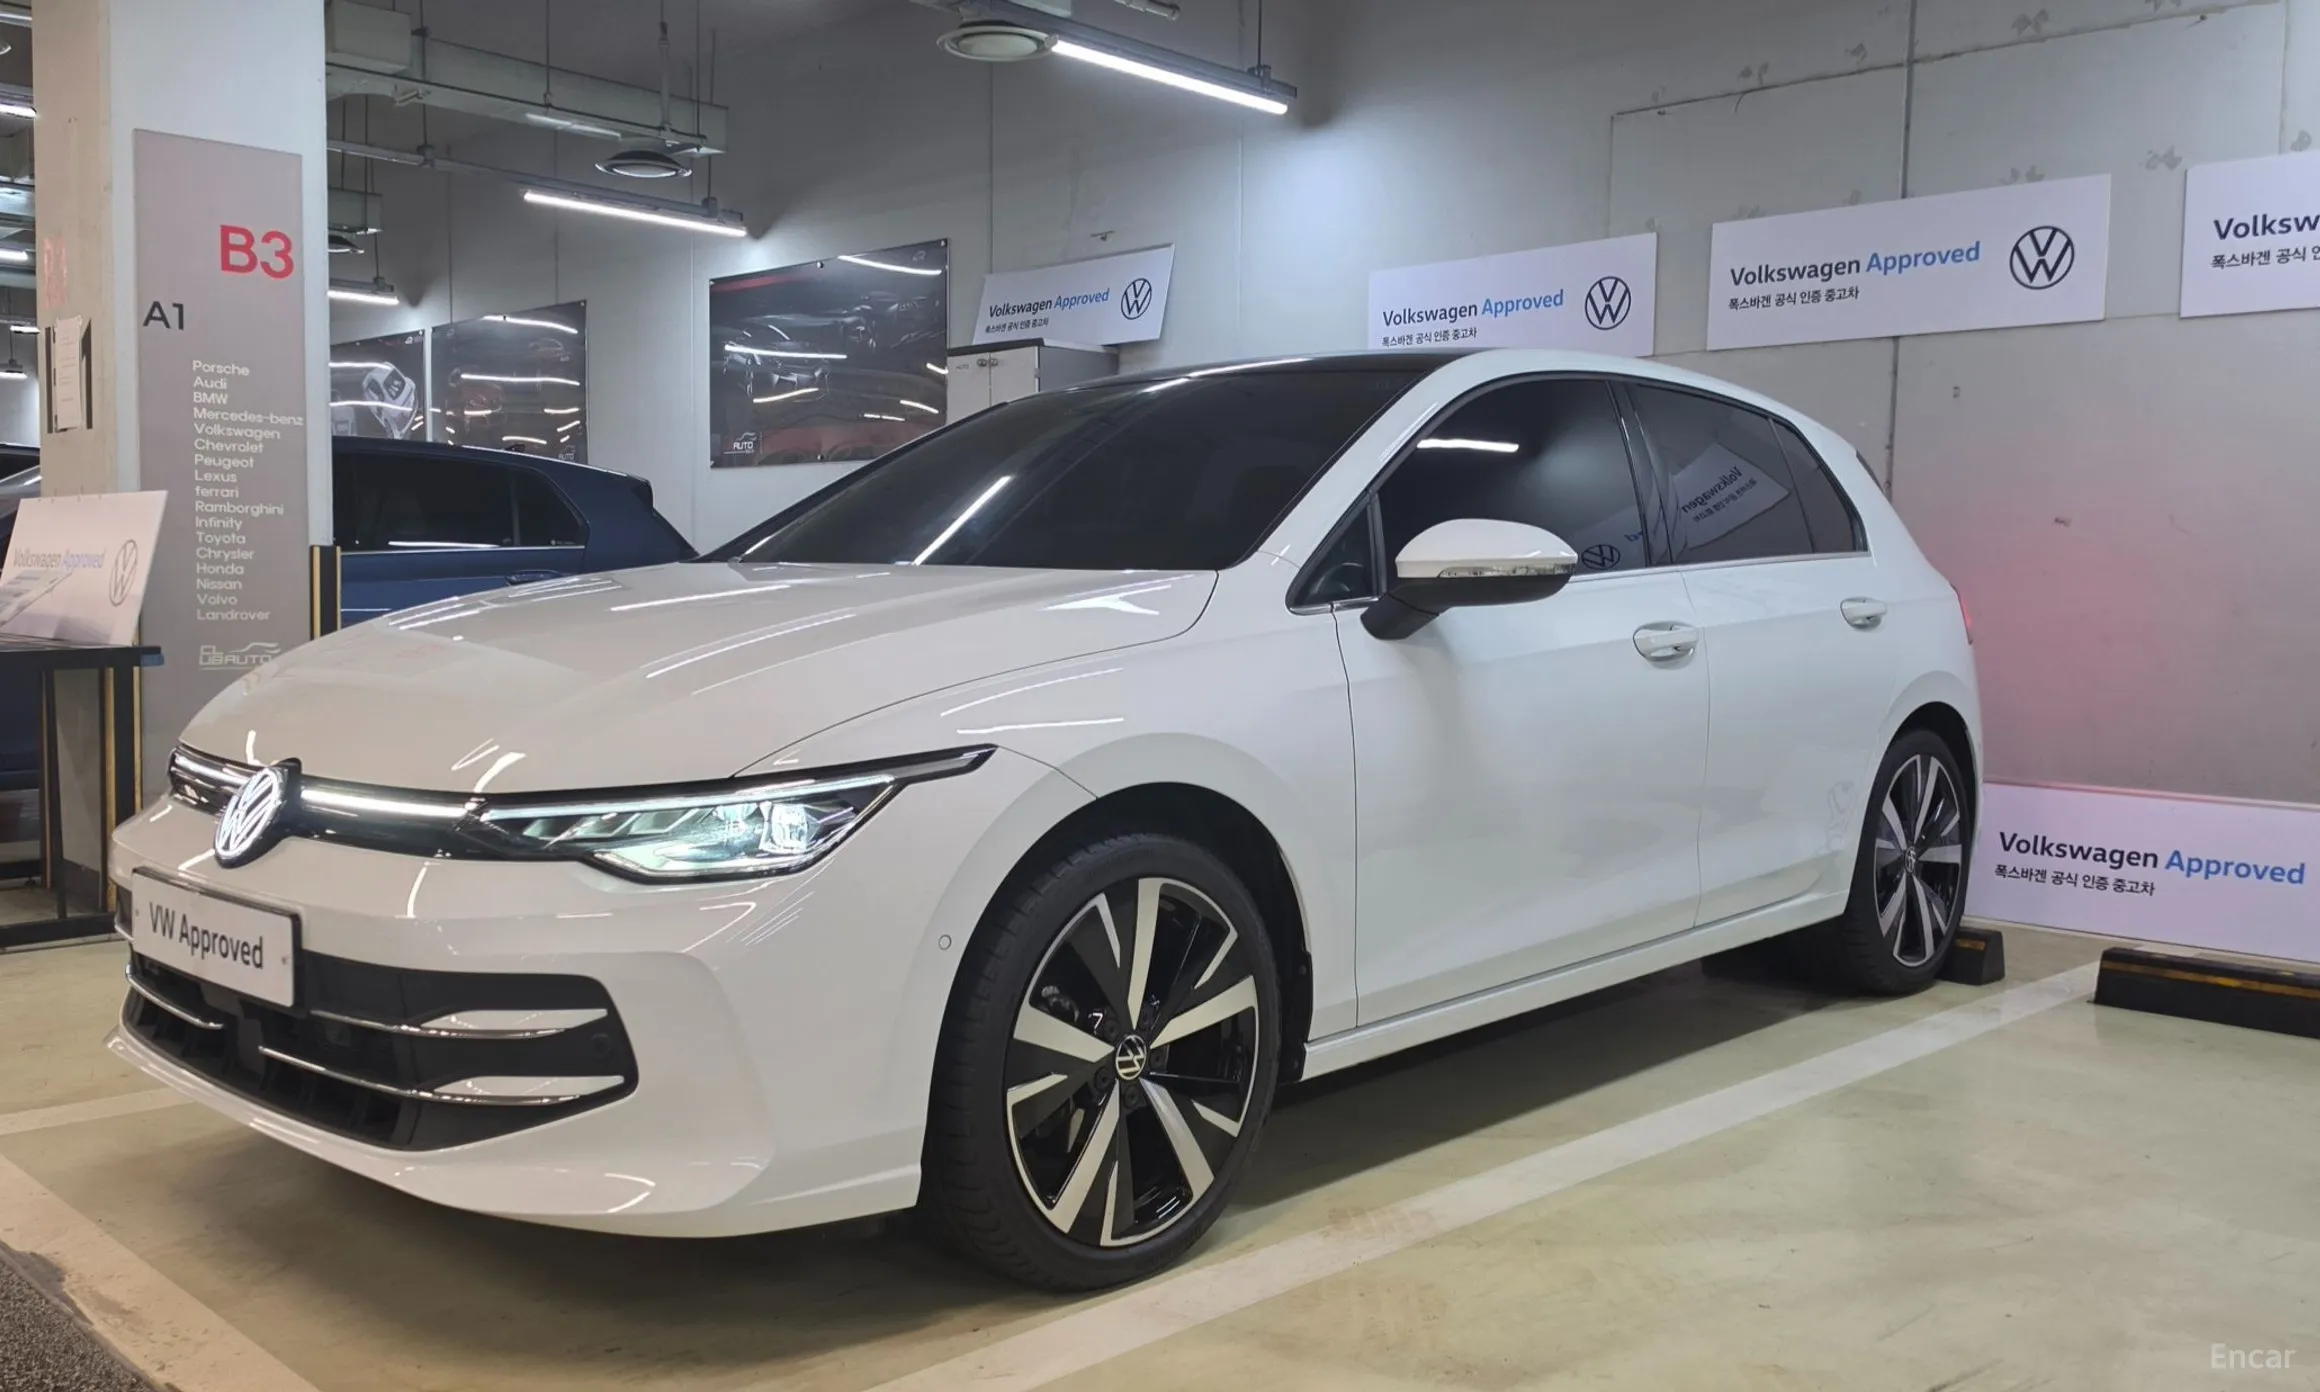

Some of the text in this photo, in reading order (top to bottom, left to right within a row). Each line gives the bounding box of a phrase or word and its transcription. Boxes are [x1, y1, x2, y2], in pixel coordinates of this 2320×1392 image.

[2213, 213, 2320, 241] Volksw
[219, 223, 295, 280] B3
[2211, 249, 2271, 269] 폭스바겐
[2276, 246, 2307, 264] 공식
[1730, 241, 1981, 286] Volkswagen Approved
[989, 288, 1110, 318] Volkswagen Approved
[1728, 285, 1859, 311] 폭스바겐 공식 인증 중고차
[142, 300, 185, 331] A1
[1382, 289, 1564, 326] Volkswagen Approved
[1382, 327, 1477, 347] 폭스바겐 공식 인증 중고차
[192, 360, 250, 376] Porsche
[193, 376, 228, 390] Audi
[193, 391, 228, 405] BMW
[193, 407, 304, 426] Mercedes-benz
[193, 423, 281, 442] Volkswagen
[194, 438, 264, 453] Chevrolet
[194, 454, 254, 470] Peugeot
[194, 470, 237, 483] Lexus
[195, 501, 284, 517] Ramborghini
[195, 516, 243, 530] Infinity
[196, 531, 246, 545] Toyota
[196, 547, 255, 561] Chrysler
[196, 562, 245, 575] Honda
[196, 578, 243, 590] Nissan
[197, 593, 238, 605] Volvo
[197, 608, 271, 621] Landrover
[1999, 832, 2306, 885] Volkswagen Approved
[1994, 864, 2155, 896] 폭스바겐 공식 인증 중고차
[149, 902, 264, 970] VW Approved
